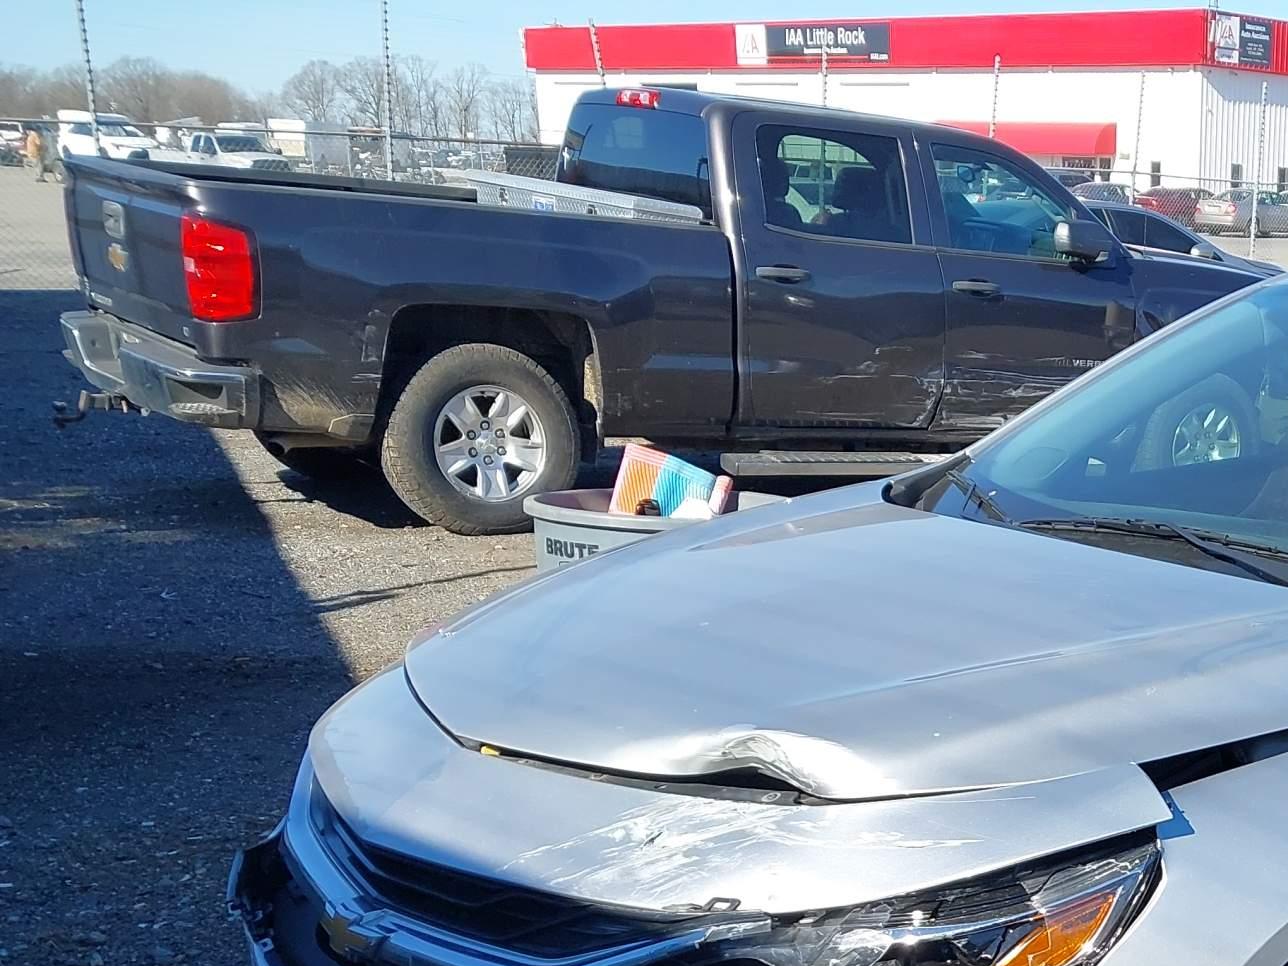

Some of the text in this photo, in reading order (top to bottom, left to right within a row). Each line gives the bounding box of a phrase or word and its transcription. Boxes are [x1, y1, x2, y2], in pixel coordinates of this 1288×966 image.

[785, 26, 866, 46] IAA Little Rock
